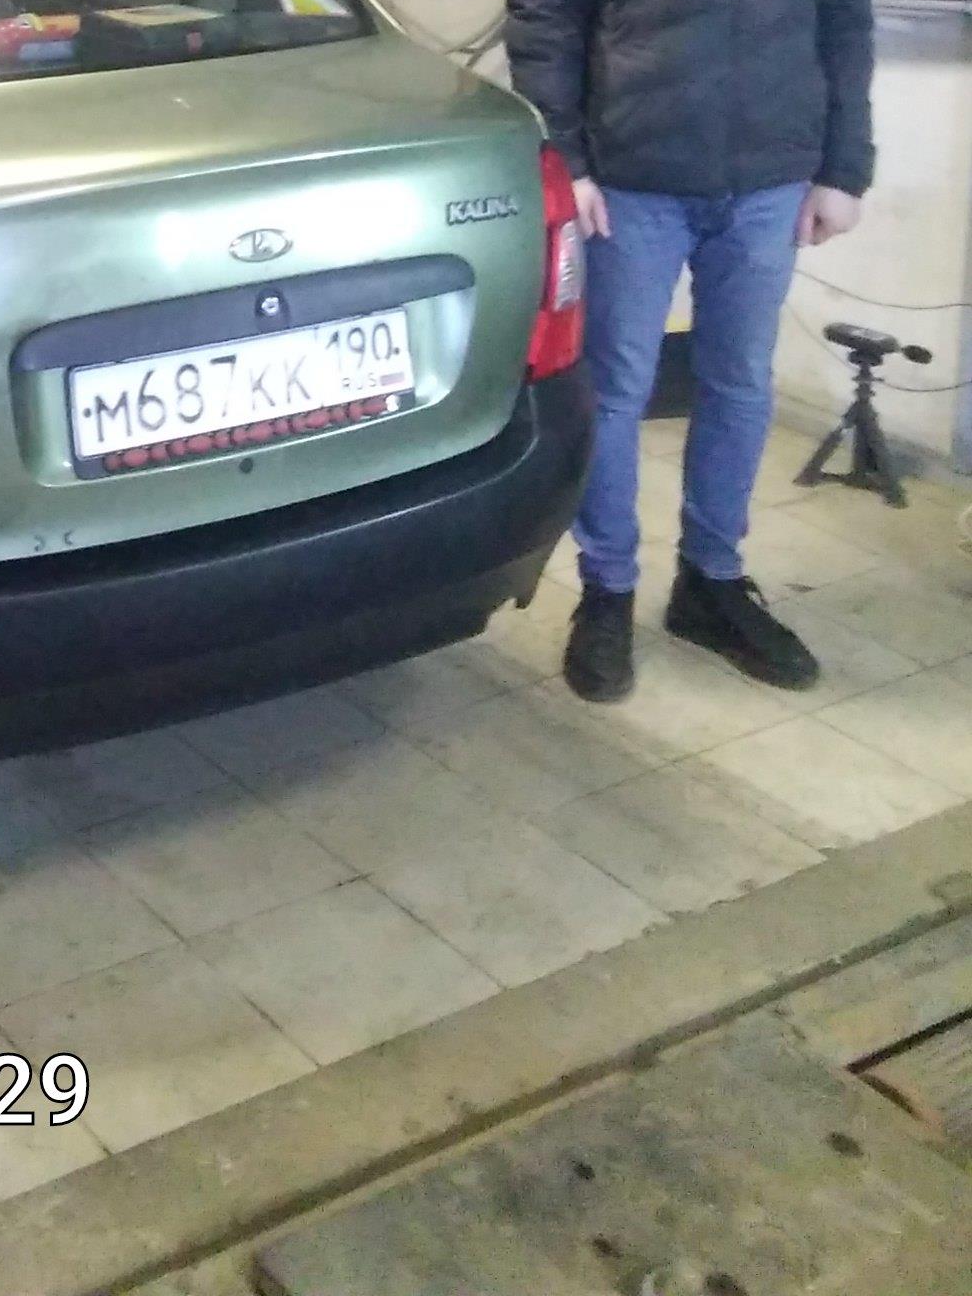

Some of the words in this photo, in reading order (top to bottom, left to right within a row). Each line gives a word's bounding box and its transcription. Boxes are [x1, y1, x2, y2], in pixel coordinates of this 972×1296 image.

[446, 196, 518, 226] KALINA
[325, 321, 393, 371] 190
[341, 372, 379, 391] RUS
